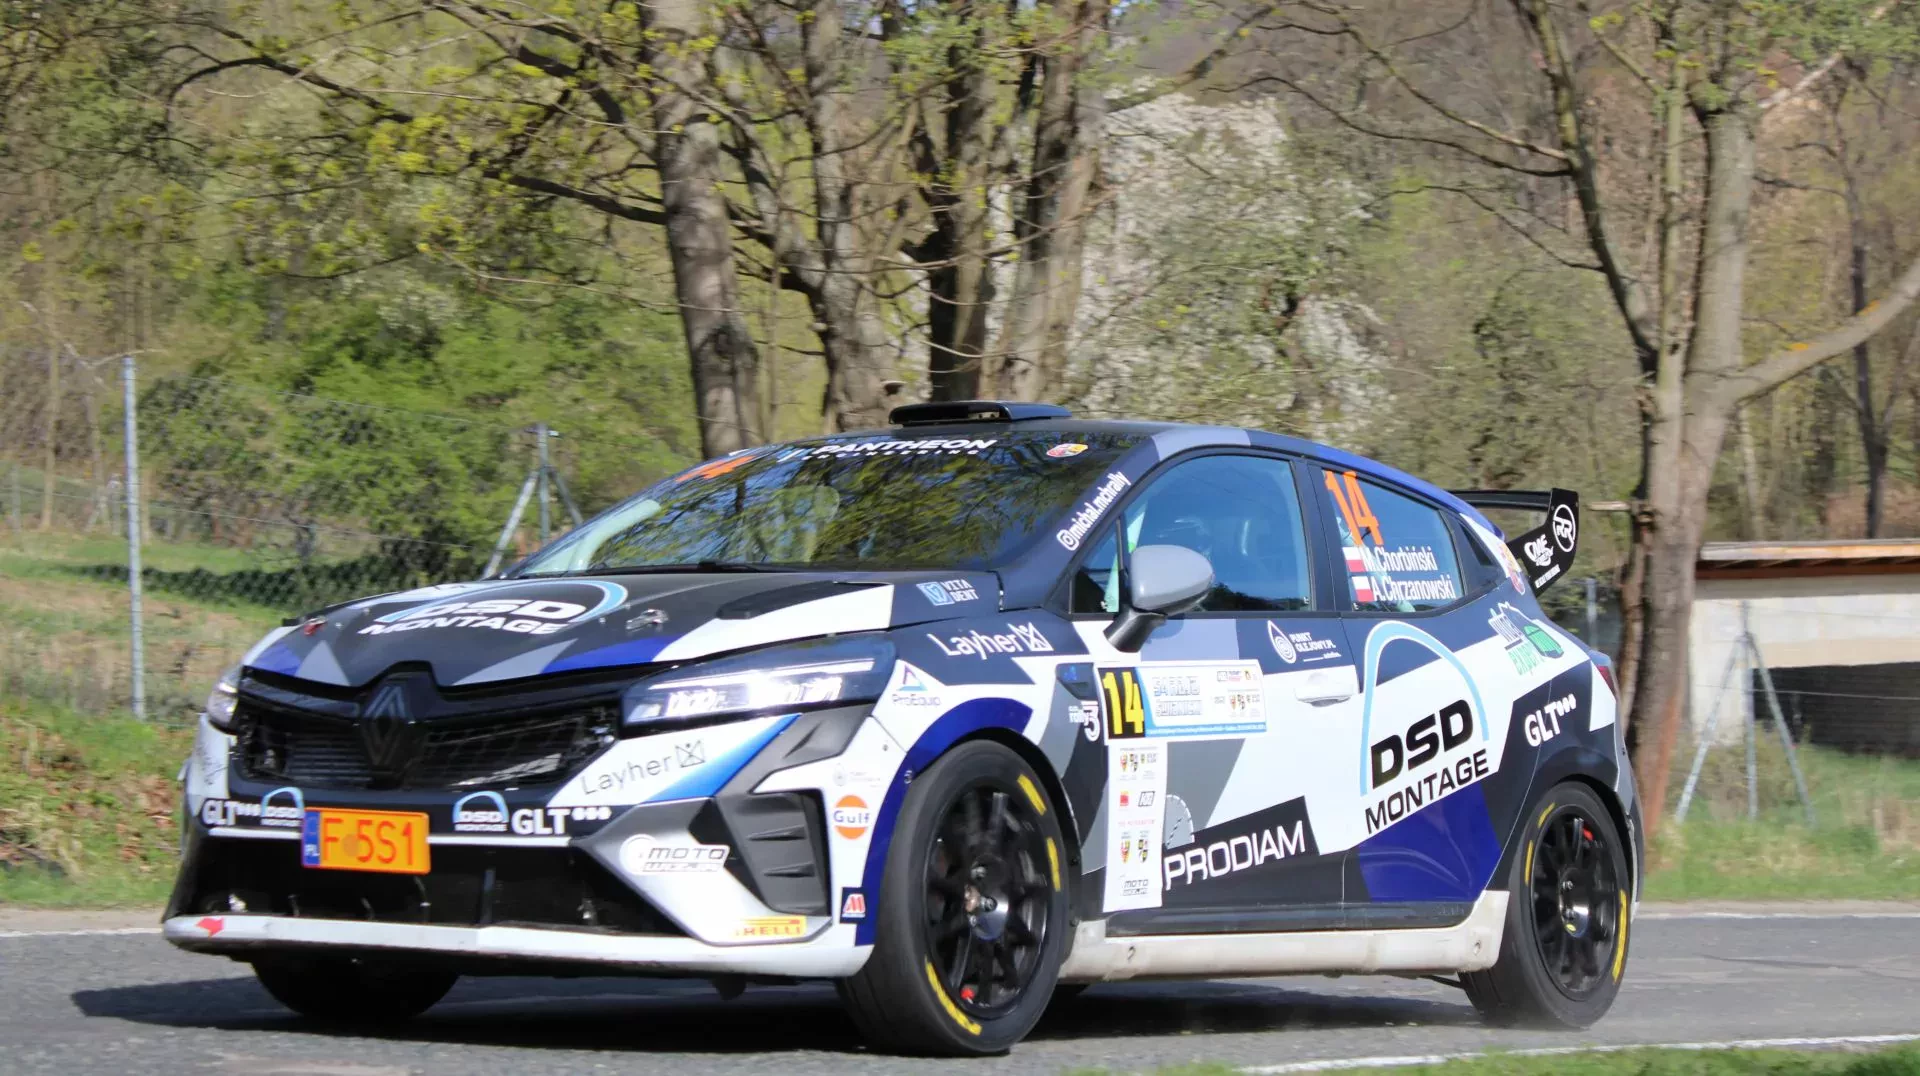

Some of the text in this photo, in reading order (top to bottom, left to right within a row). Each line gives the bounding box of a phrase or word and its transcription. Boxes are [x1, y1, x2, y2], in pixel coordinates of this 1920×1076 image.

[813, 439, 999, 455] PANTHEON
[1325, 470, 1384, 546] 14
[940, 579, 973, 591] VITA
[949, 589, 979, 602] DENT
[1370, 574, 1457, 601] A.Chrzanowski
[401, 600, 587, 620] DSD
[357, 616, 570, 635] MONTAGE
[926, 630, 1024, 660] Layher
[1102, 671, 1145, 735] 14
[1525, 701, 1561, 747] GLT
[1371, 699, 1474, 790] DSD
[580, 755, 672, 796] Layher
[1365, 748, 1490, 835] MONTAGE
[202, 800, 237, 826] GLT
[511, 808, 571, 835] GLT
[834, 810, 870, 824] Gulf
[648, 847, 726, 860] MOTO
[1163, 820, 1306, 891] PRODIAM
